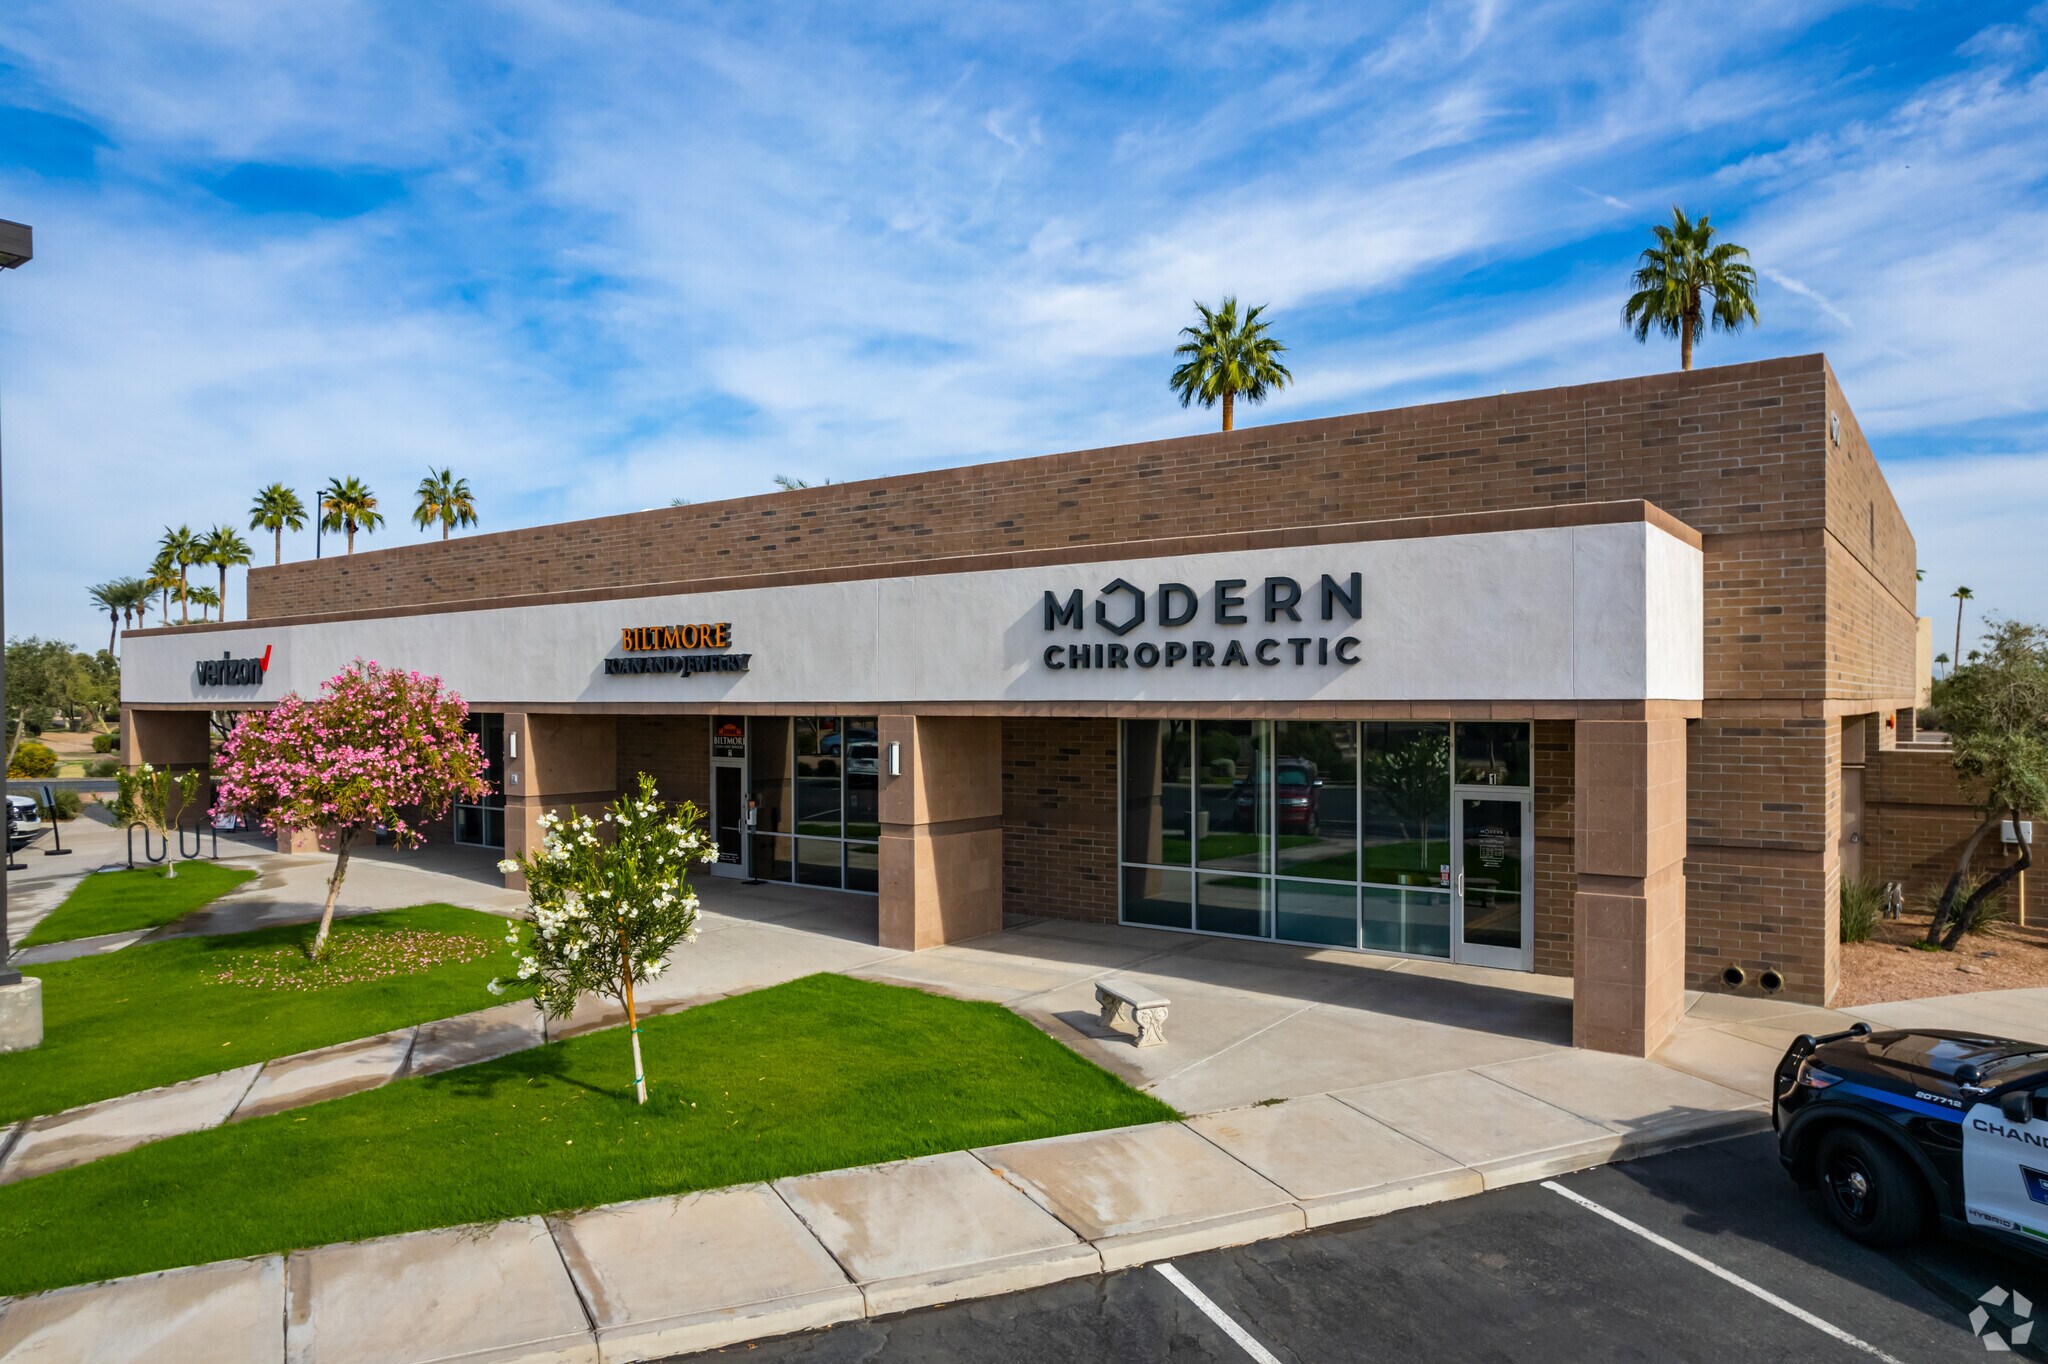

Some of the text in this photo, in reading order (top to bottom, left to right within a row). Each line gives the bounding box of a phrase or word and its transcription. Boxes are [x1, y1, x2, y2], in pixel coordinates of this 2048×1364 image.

[1044, 572, 1362, 636] MODERN
[622, 623, 732, 651] BILTMORE
[644, 656, 681, 674] AND
[1043, 636, 1362, 670] CHIROPRACTIC
[196, 650, 264, 687] verizon
[1915, 1091, 1962, 1108] 207712
[1968, 1208, 2011, 1228] HYBRID
